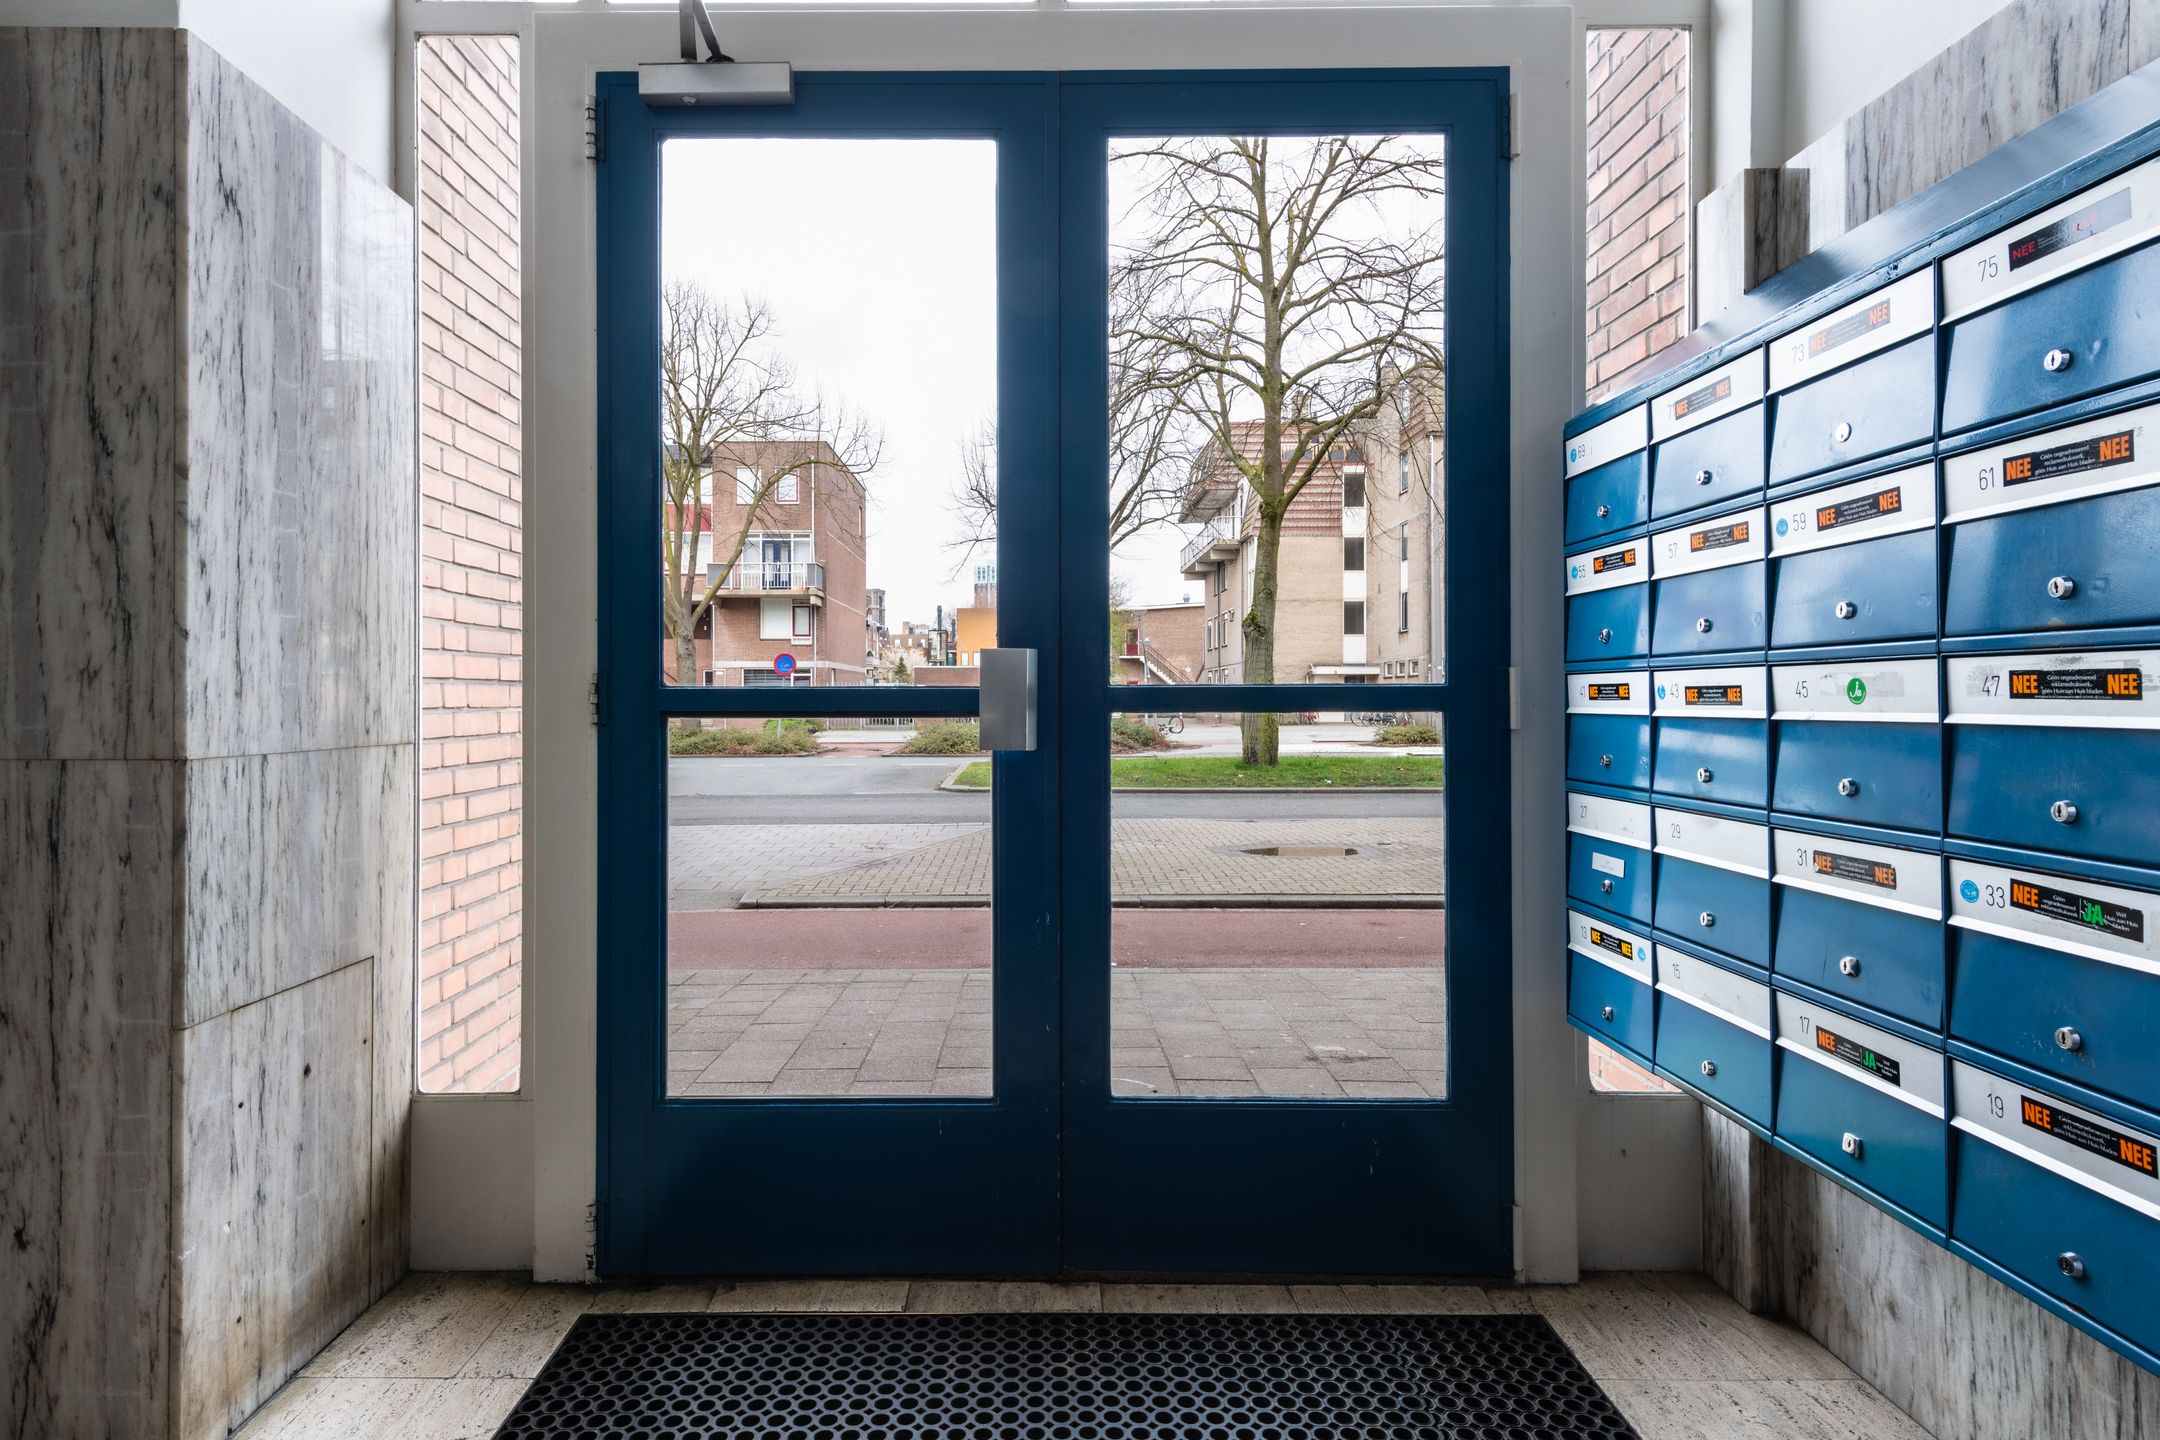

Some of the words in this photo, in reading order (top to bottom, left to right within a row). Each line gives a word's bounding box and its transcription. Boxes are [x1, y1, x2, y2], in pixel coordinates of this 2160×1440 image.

[2012, 241, 2037, 261] NEE
[1978, 255, 1998, 282] 75
[1868, 303, 1889, 326] NEE
[1792, 344, 1805, 364] 73
[1677, 400, 1689, 417] NEE
[1578, 444, 1585, 458] 69
[2099, 435, 2130, 461] NEE
[2006, 457, 2032, 481] NEE
[2046, 465, 2057, 473] Huis
[2067, 461, 2078, 469] Huis
[2079, 457, 2096, 467] bladen
[1979, 467, 1995, 490] 61
[1878, 491, 1899, 512] NEE
[1792, 512, 1806, 532] 59
[1818, 508, 1836, 527] NEE
[1691, 534, 1704, 549] NEE
[1733, 524, 1748, 541] NEE
[1624, 551, 1635, 565] NEE
[1668, 542, 1678, 559] 57
[1595, 558, 1604, 571] NEE
[1590, 686, 1599, 698] NEE
[1619, 685, 1629, 698] NEE
[1670, 683, 1680, 699] 43
[1795, 680, 1809, 699] 45
[1981, 675, 2000, 697] 47
[2012, 674, 2038, 694] NEE
[2107, 673, 2139, 695] NEE
[1686, 688, 1698, 702] NEE
[1728, 687, 1741, 702] NEE
[1580, 805, 1587, 819] 27
[1671, 823, 1681, 839] 29
[1797, 848, 1808, 867] 31
[1815, 854, 1832, 872] NEE
[1874, 865, 1895, 885] NEE
[1986, 884, 2006, 909] 33
[2013, 884, 2039, 908] NEE
[2083, 902, 2104, 926] JA
[1592, 929, 1601, 944] NEE
[1622, 942, 1632, 957] NEE
[1672, 963, 1681, 980] 15
[1799, 1015, 1810, 1035] 17
[1818, 1030, 1836, 1052] NEE
[1862, 1050, 1877, 1070] JA
[1987, 1093, 2005, 1119] 19
[2024, 1101, 2052, 1129] NEE
[2120, 1139, 2152, 1171] NEE
